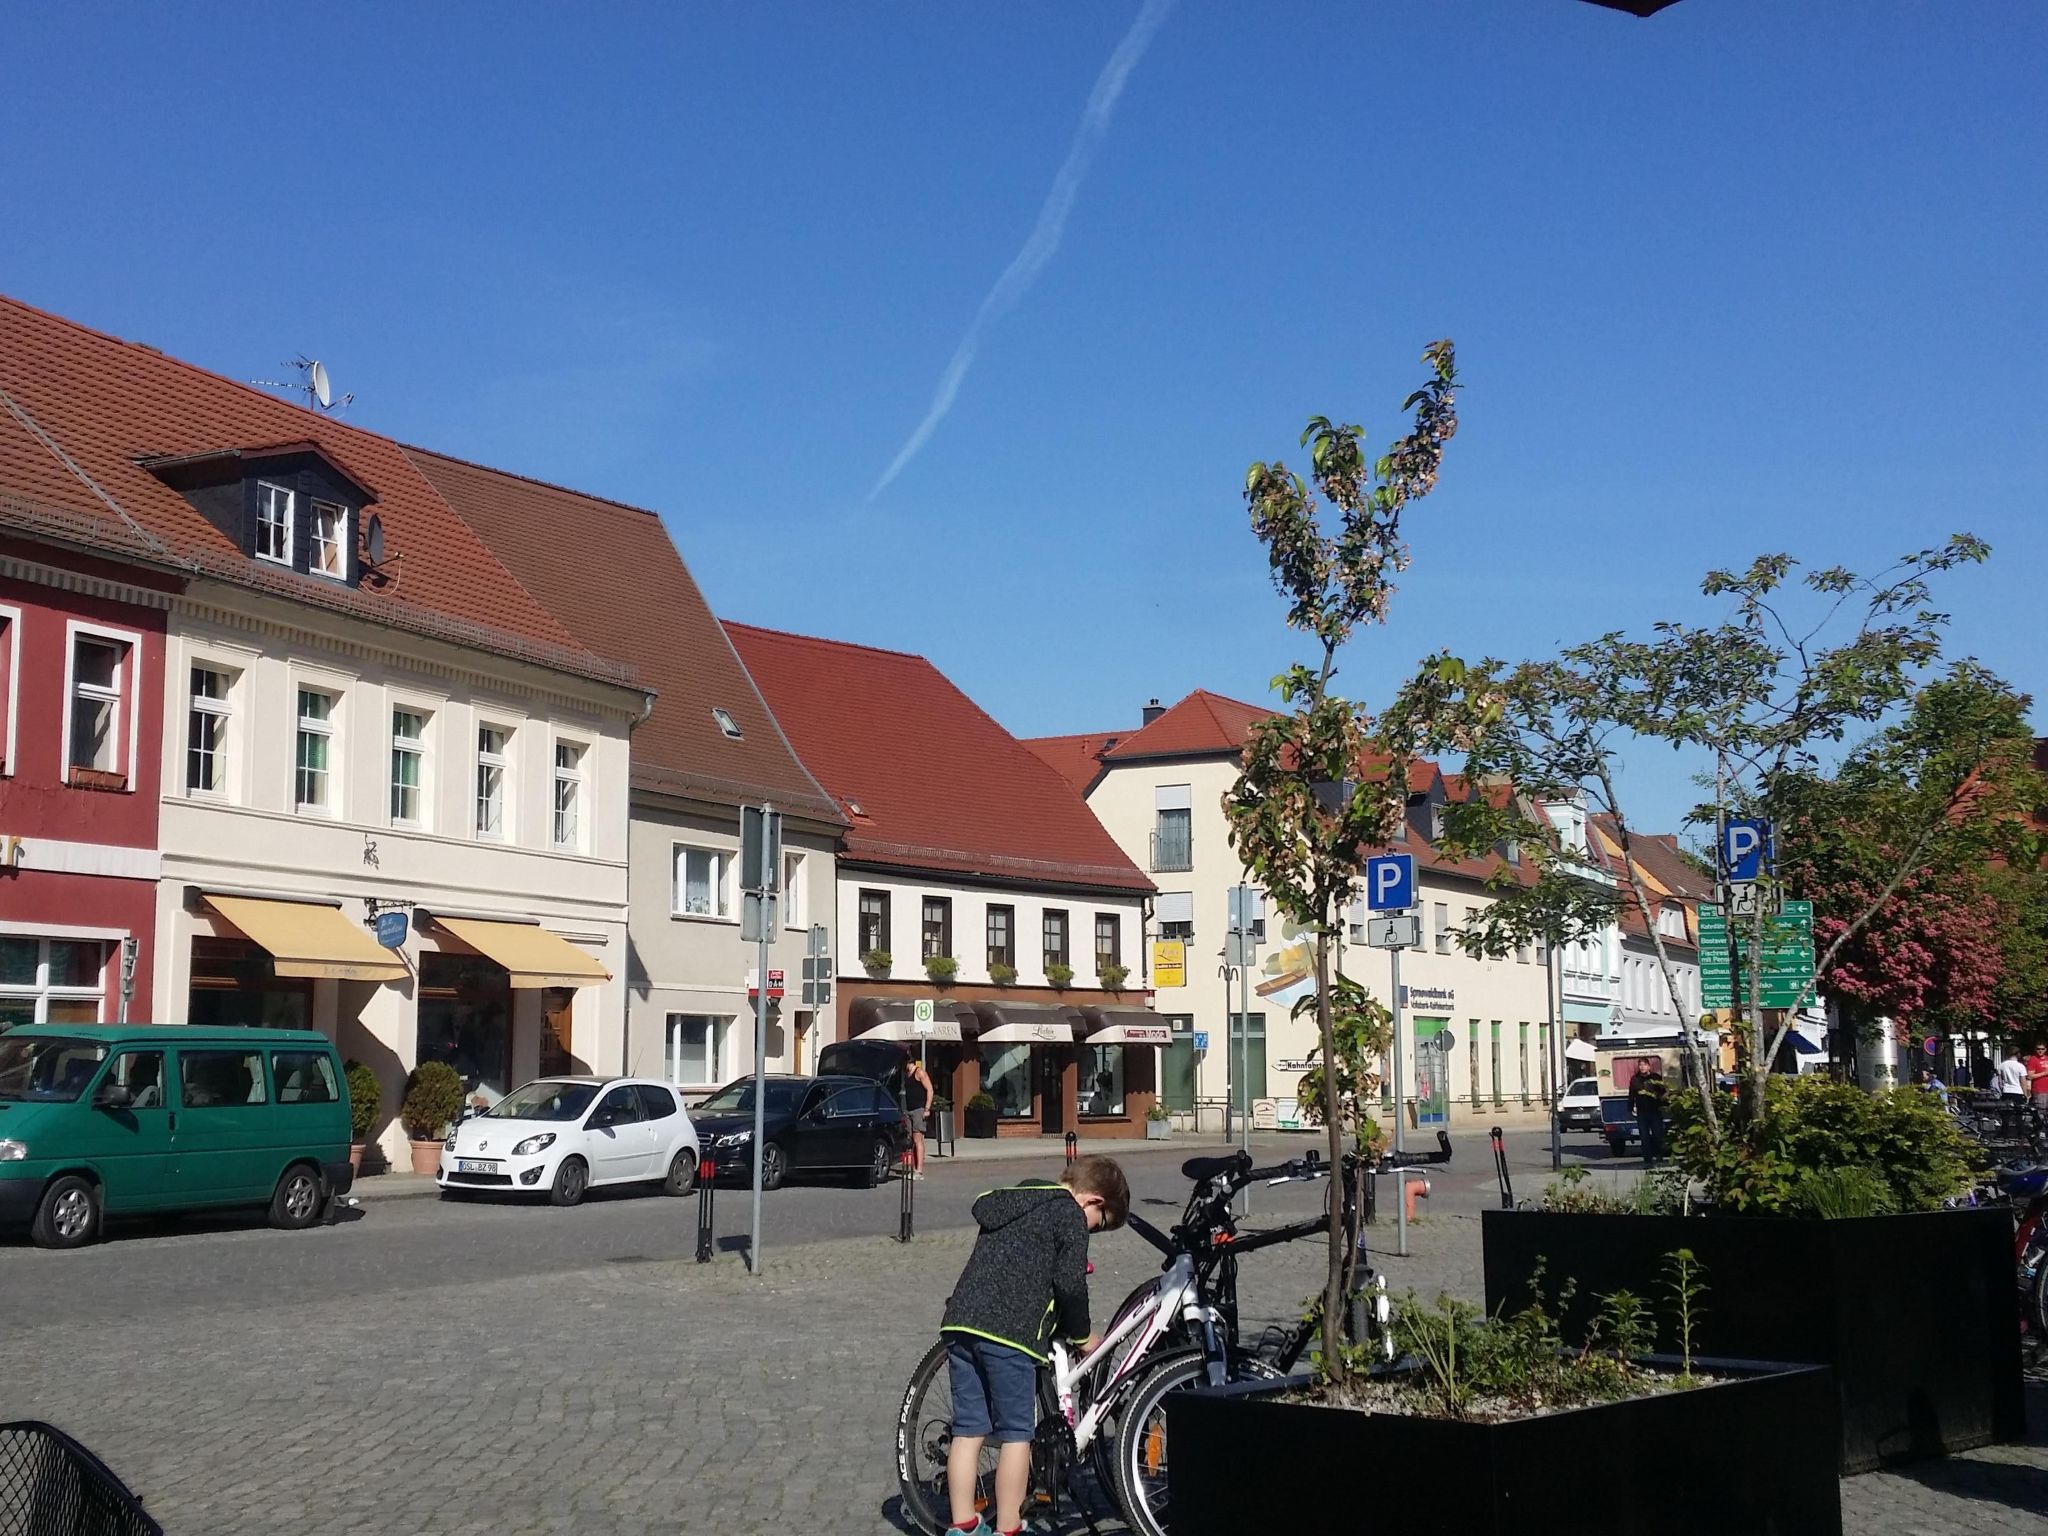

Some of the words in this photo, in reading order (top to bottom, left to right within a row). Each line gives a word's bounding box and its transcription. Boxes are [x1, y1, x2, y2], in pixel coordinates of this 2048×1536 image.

[1729, 826, 1759, 873] P
[1377, 863, 1401, 903] P
[920, 1005, 928, 1017] H
[901, 1385, 917, 1424] PACE
[898, 1428, 905, 1450] OF
[899, 1454, 909, 1482] ACE
